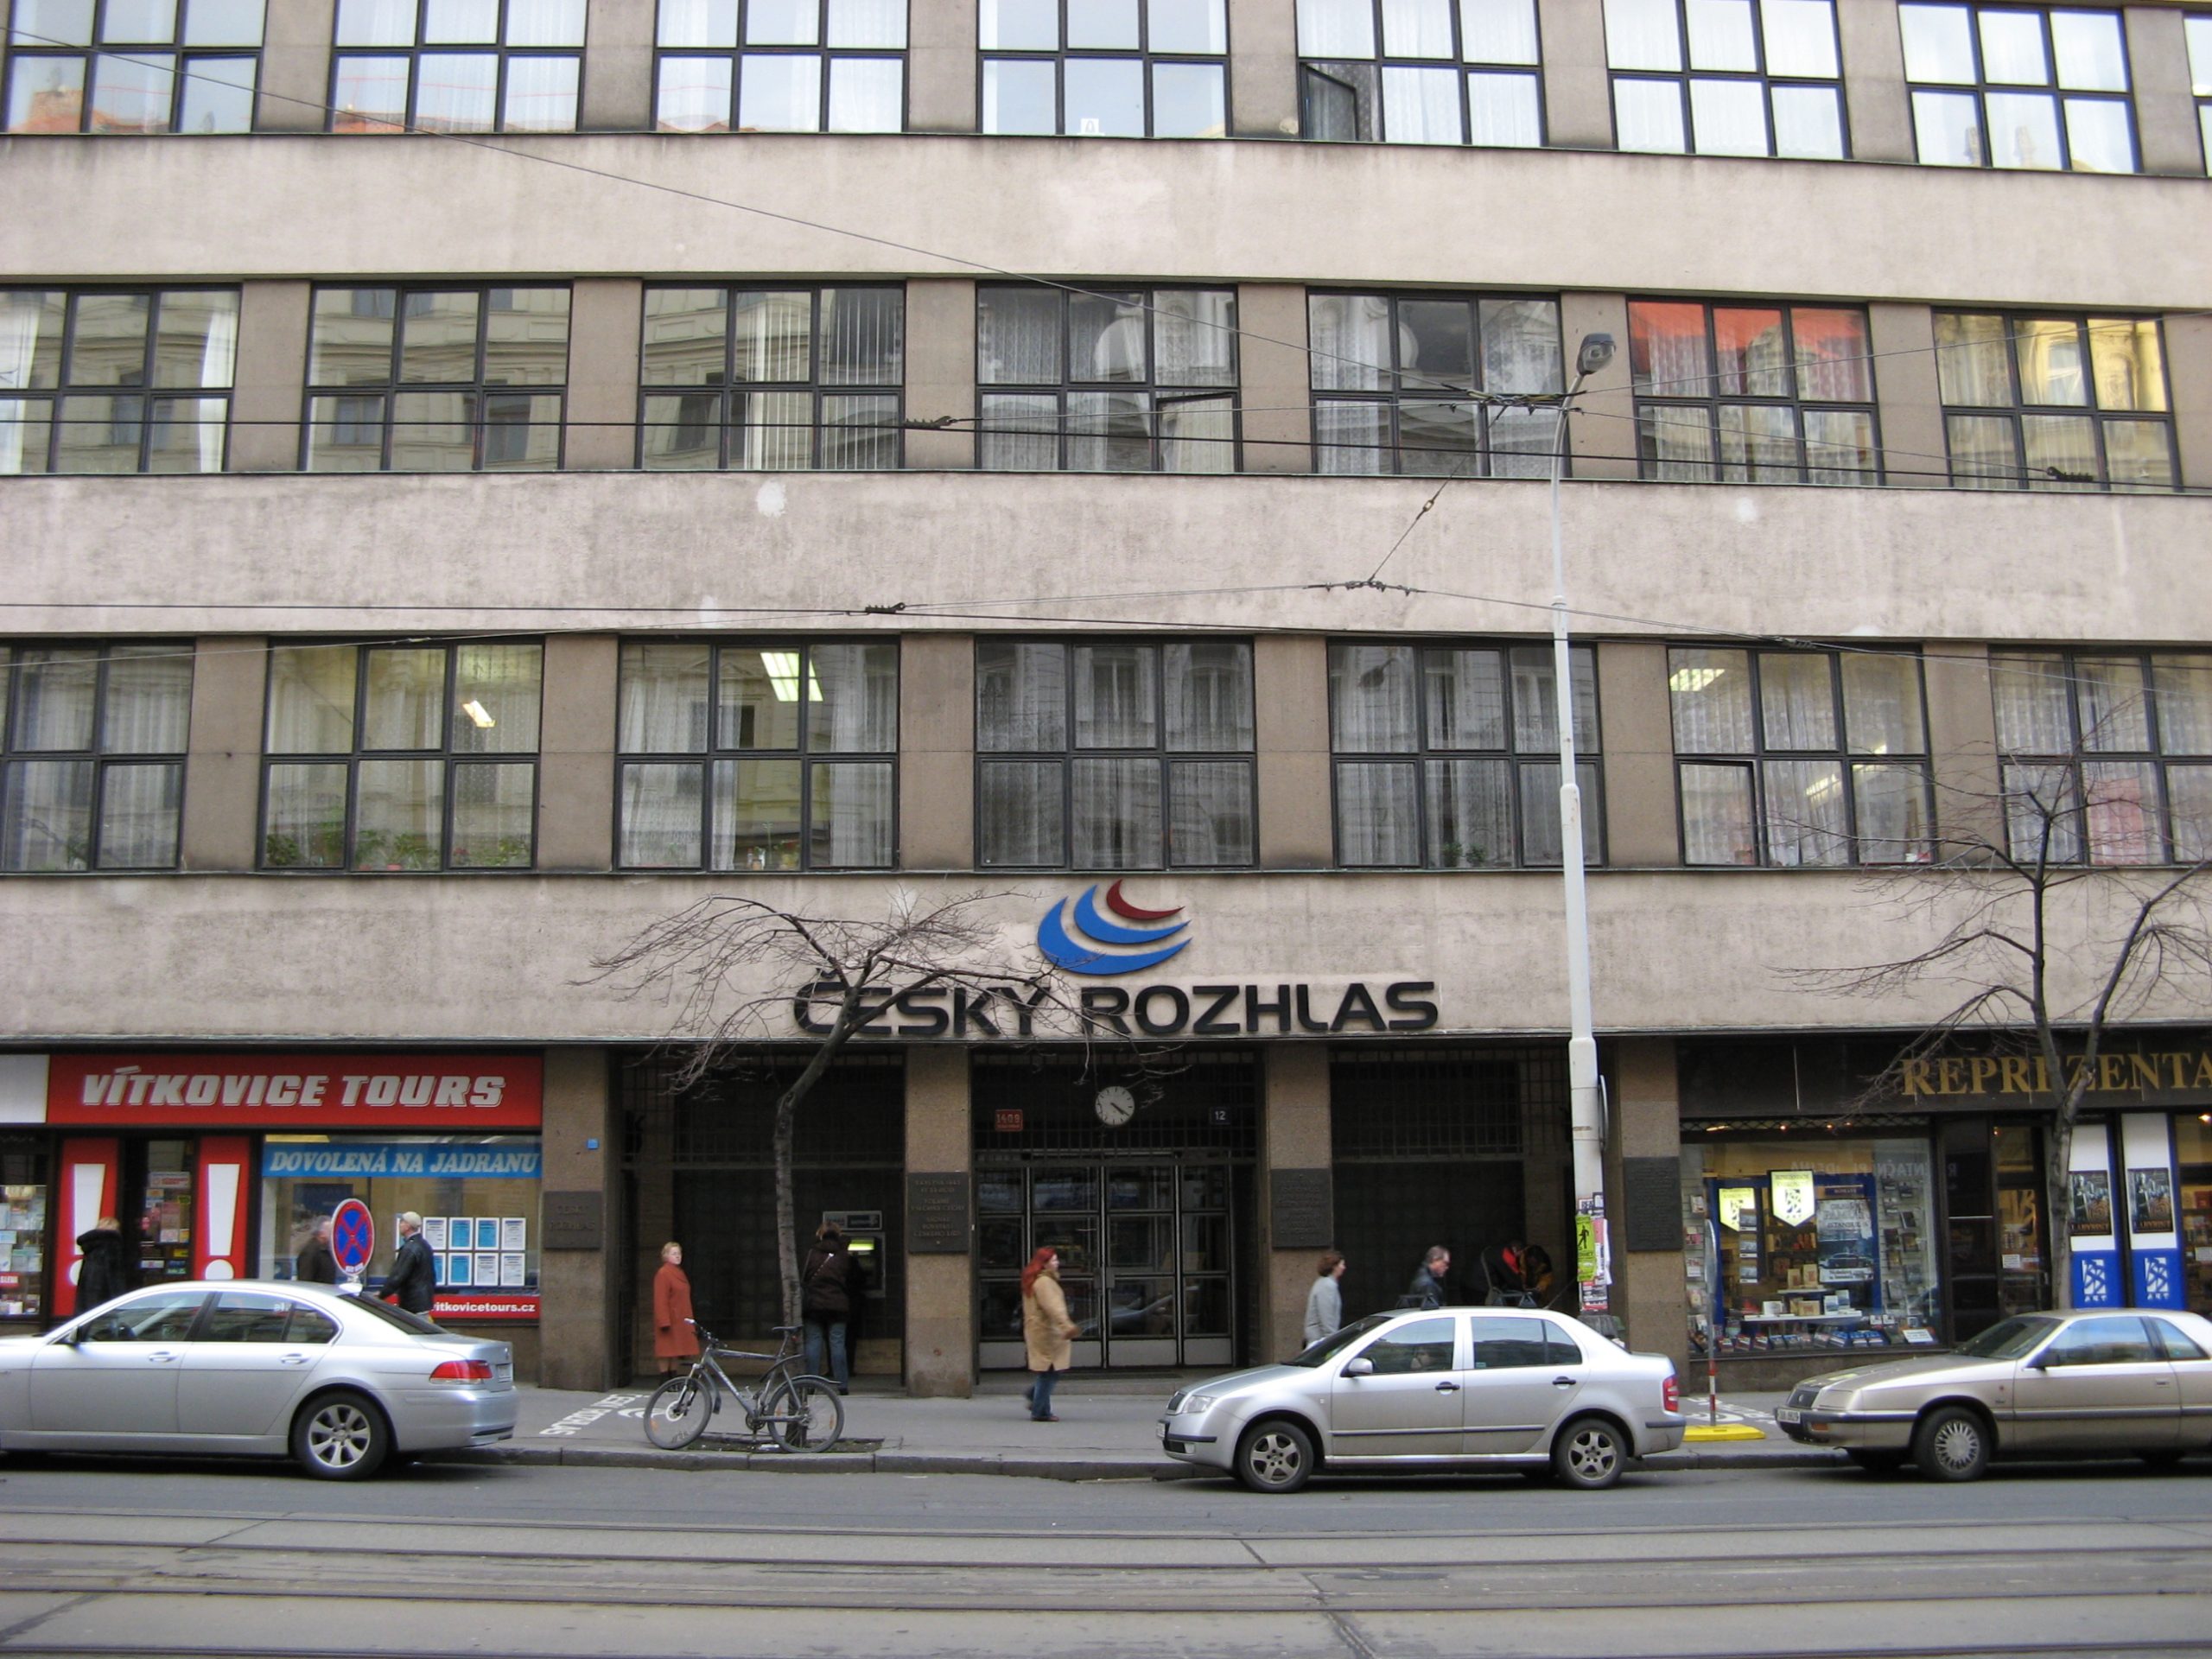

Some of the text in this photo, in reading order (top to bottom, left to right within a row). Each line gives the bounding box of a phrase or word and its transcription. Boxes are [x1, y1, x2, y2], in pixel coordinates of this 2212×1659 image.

[793, 969, 1439, 1034] ČESKÝ ROZHLAS
[83, 1065, 505, 1108] VÍTKOVICE TOURS
[1215, 1110, 1226, 1120] 12
[270, 1147, 540, 1173] DOVOLENÁ NA JADRANU
